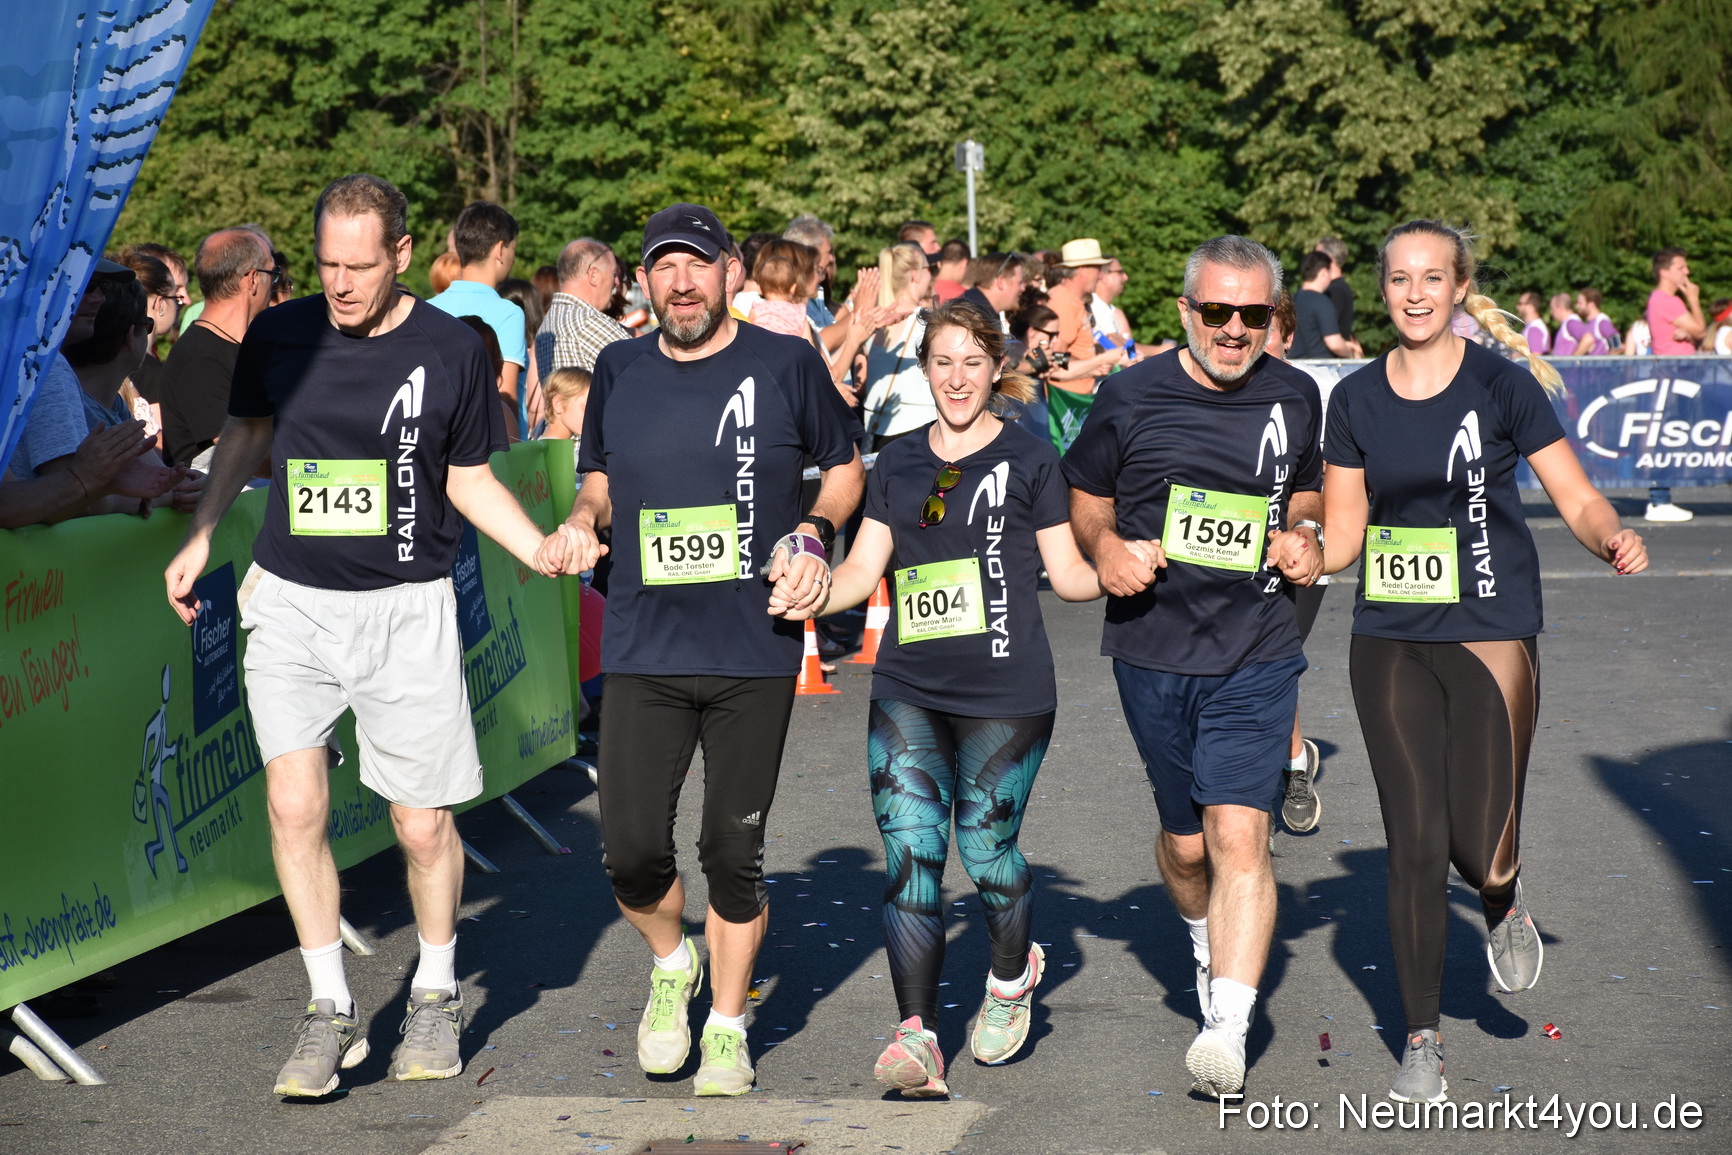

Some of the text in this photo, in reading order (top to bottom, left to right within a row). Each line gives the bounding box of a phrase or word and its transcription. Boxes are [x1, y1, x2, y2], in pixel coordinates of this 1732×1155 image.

[298, 487, 373, 514] 2143
[397, 426, 420, 562] RAIL.ONE
[736, 435, 756, 580] RAIL.ONE
[651, 533, 725, 563] 1599
[1179, 514, 1252, 549] 1594
[1185, 542, 1240, 557] Gezmis Kemal
[1467, 467, 1497, 598] RAIL.ONE
[455, 554, 476, 584] Fischer
[663, 562, 715, 571] Bode Torsten
[1375, 553, 1443, 582] 1610
[5, 567, 64, 633] Firmen
[905, 586, 970, 621] 1604
[986, 515, 1010, 658] RAIL.ONE
[1381, 581, 1436, 590] Riedel Caroline
[200, 617, 231, 654] Fischer
[911, 616, 963, 629] Damerow Maria
[20, 612, 89, 712] länger!
[203, 641, 229, 667] AUTOMOBILE
[464, 596, 526, 708] rmenlauf
[475, 702, 498, 740] markt
[176, 686, 261, 820] firmenl
[189, 795, 243, 858] neumarkt
